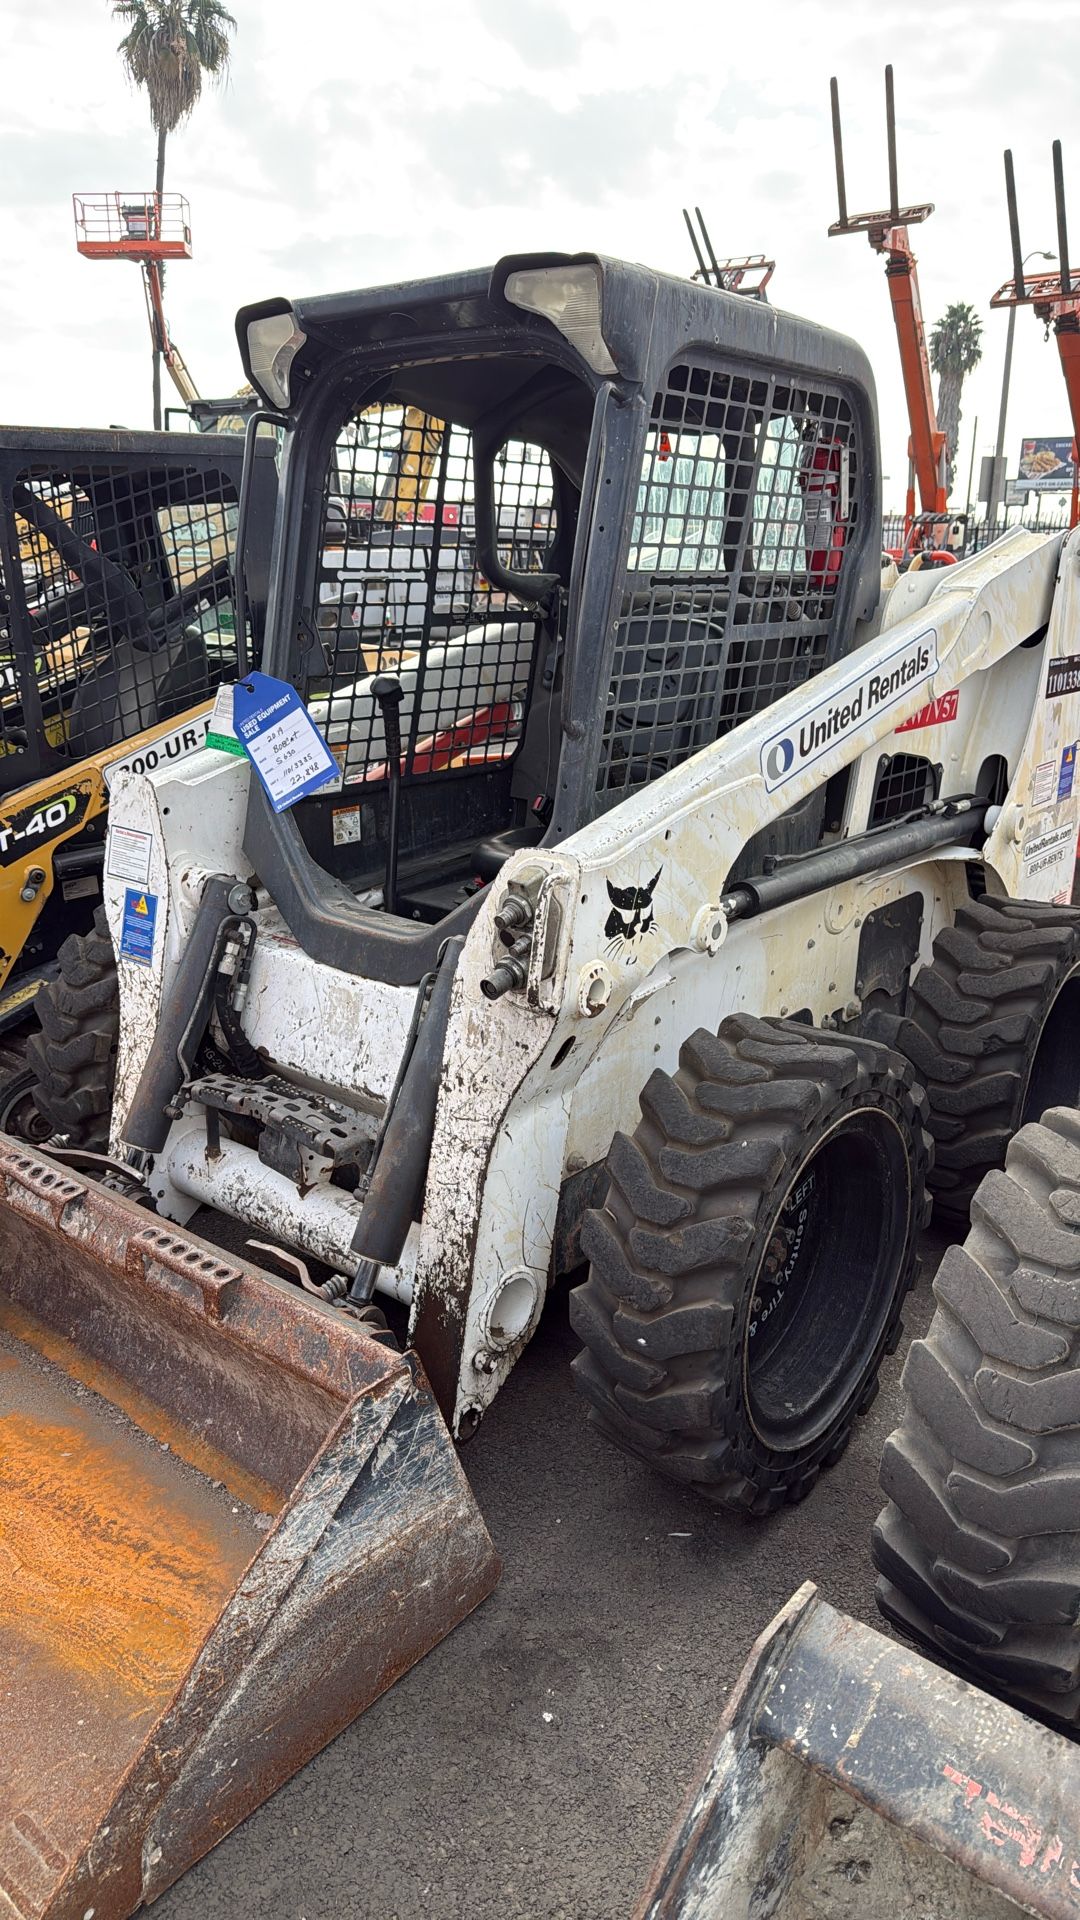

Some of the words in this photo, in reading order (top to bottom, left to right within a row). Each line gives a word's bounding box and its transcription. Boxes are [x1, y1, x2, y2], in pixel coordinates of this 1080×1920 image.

[240, 718, 258, 733] USED
[256, 693, 291, 722] EQUIPMENT
[800, 687, 864, 758] United
[867, 645, 930, 711] Rentals
[243, 724, 261, 739] SALE
[1025, 828, 1072, 857] UnitedRentals.com
[790, 1175, 815, 1210] LEFT
[784, 1208, 808, 1282] Sentry
[761, 1289, 785, 1322] Tire
